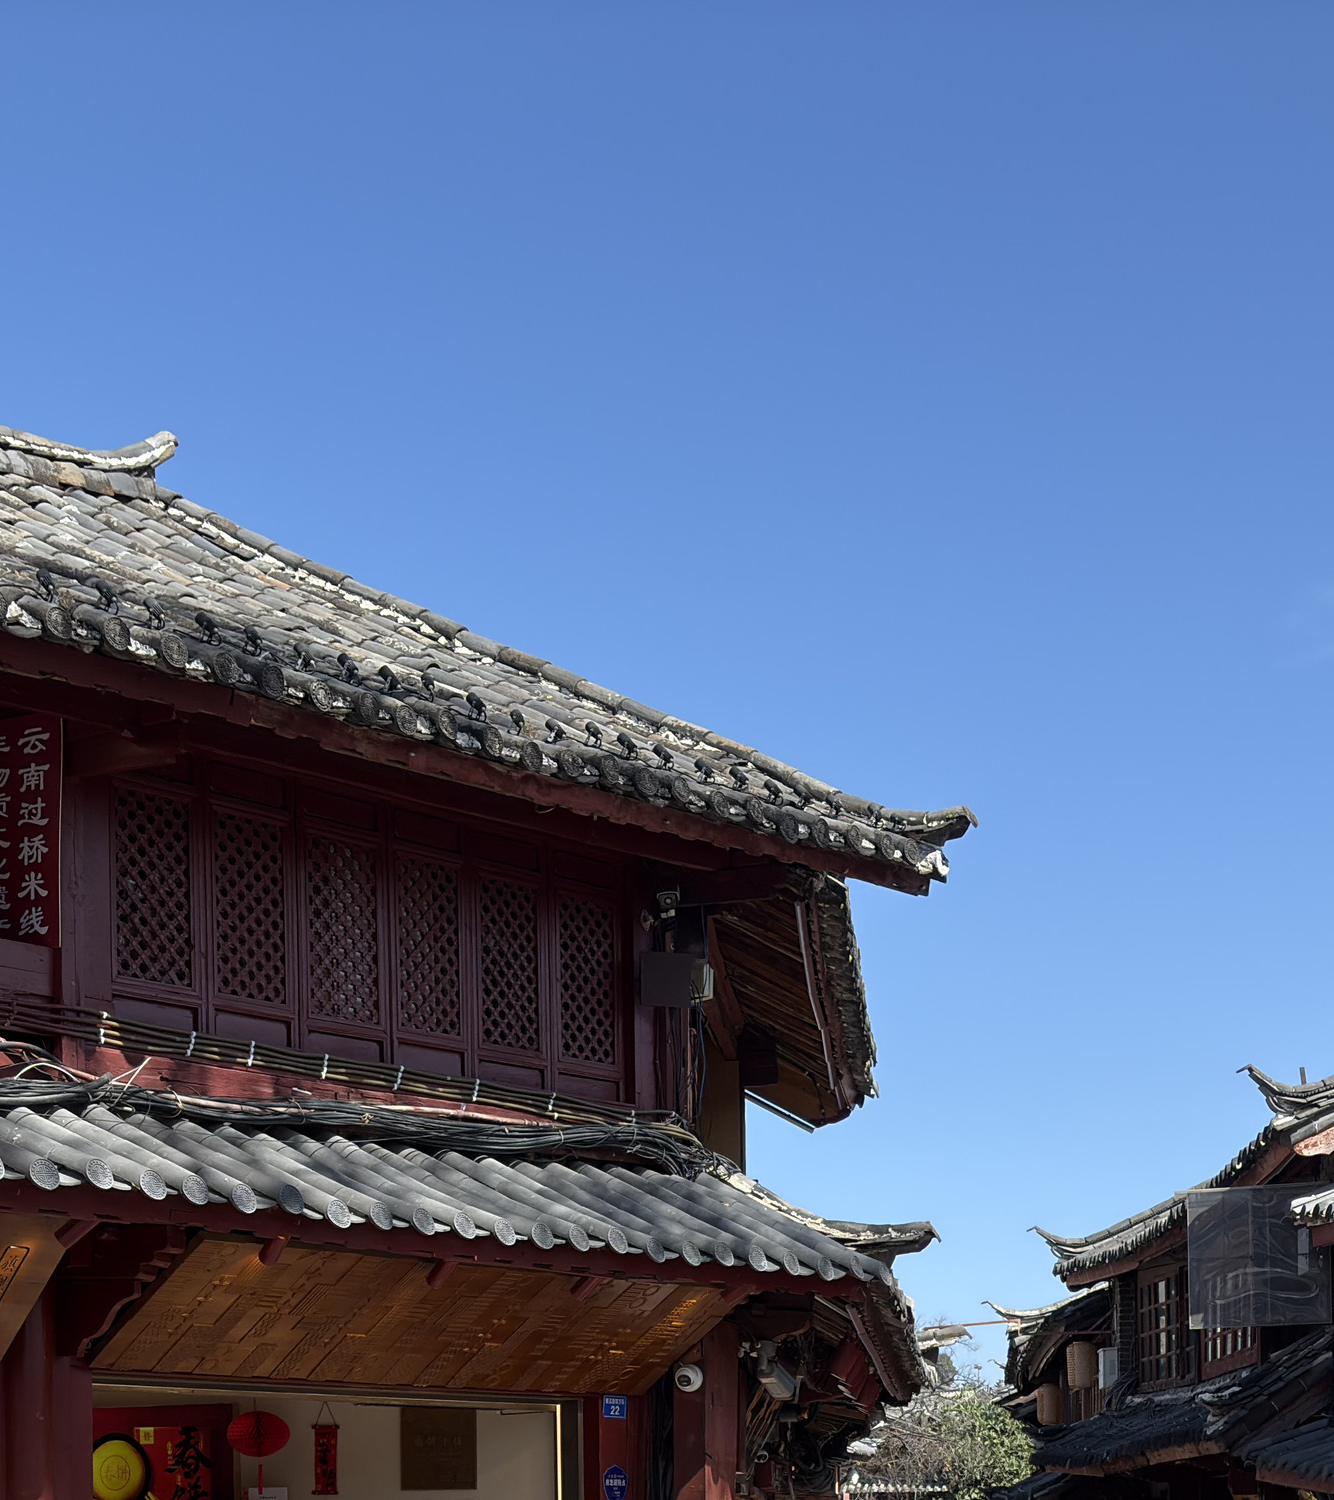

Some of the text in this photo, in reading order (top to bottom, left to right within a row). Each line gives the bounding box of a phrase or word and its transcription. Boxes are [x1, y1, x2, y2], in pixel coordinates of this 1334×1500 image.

[17, 727, 50, 936] 云南过桥米线
[610, 1405, 620, 1415] 22
